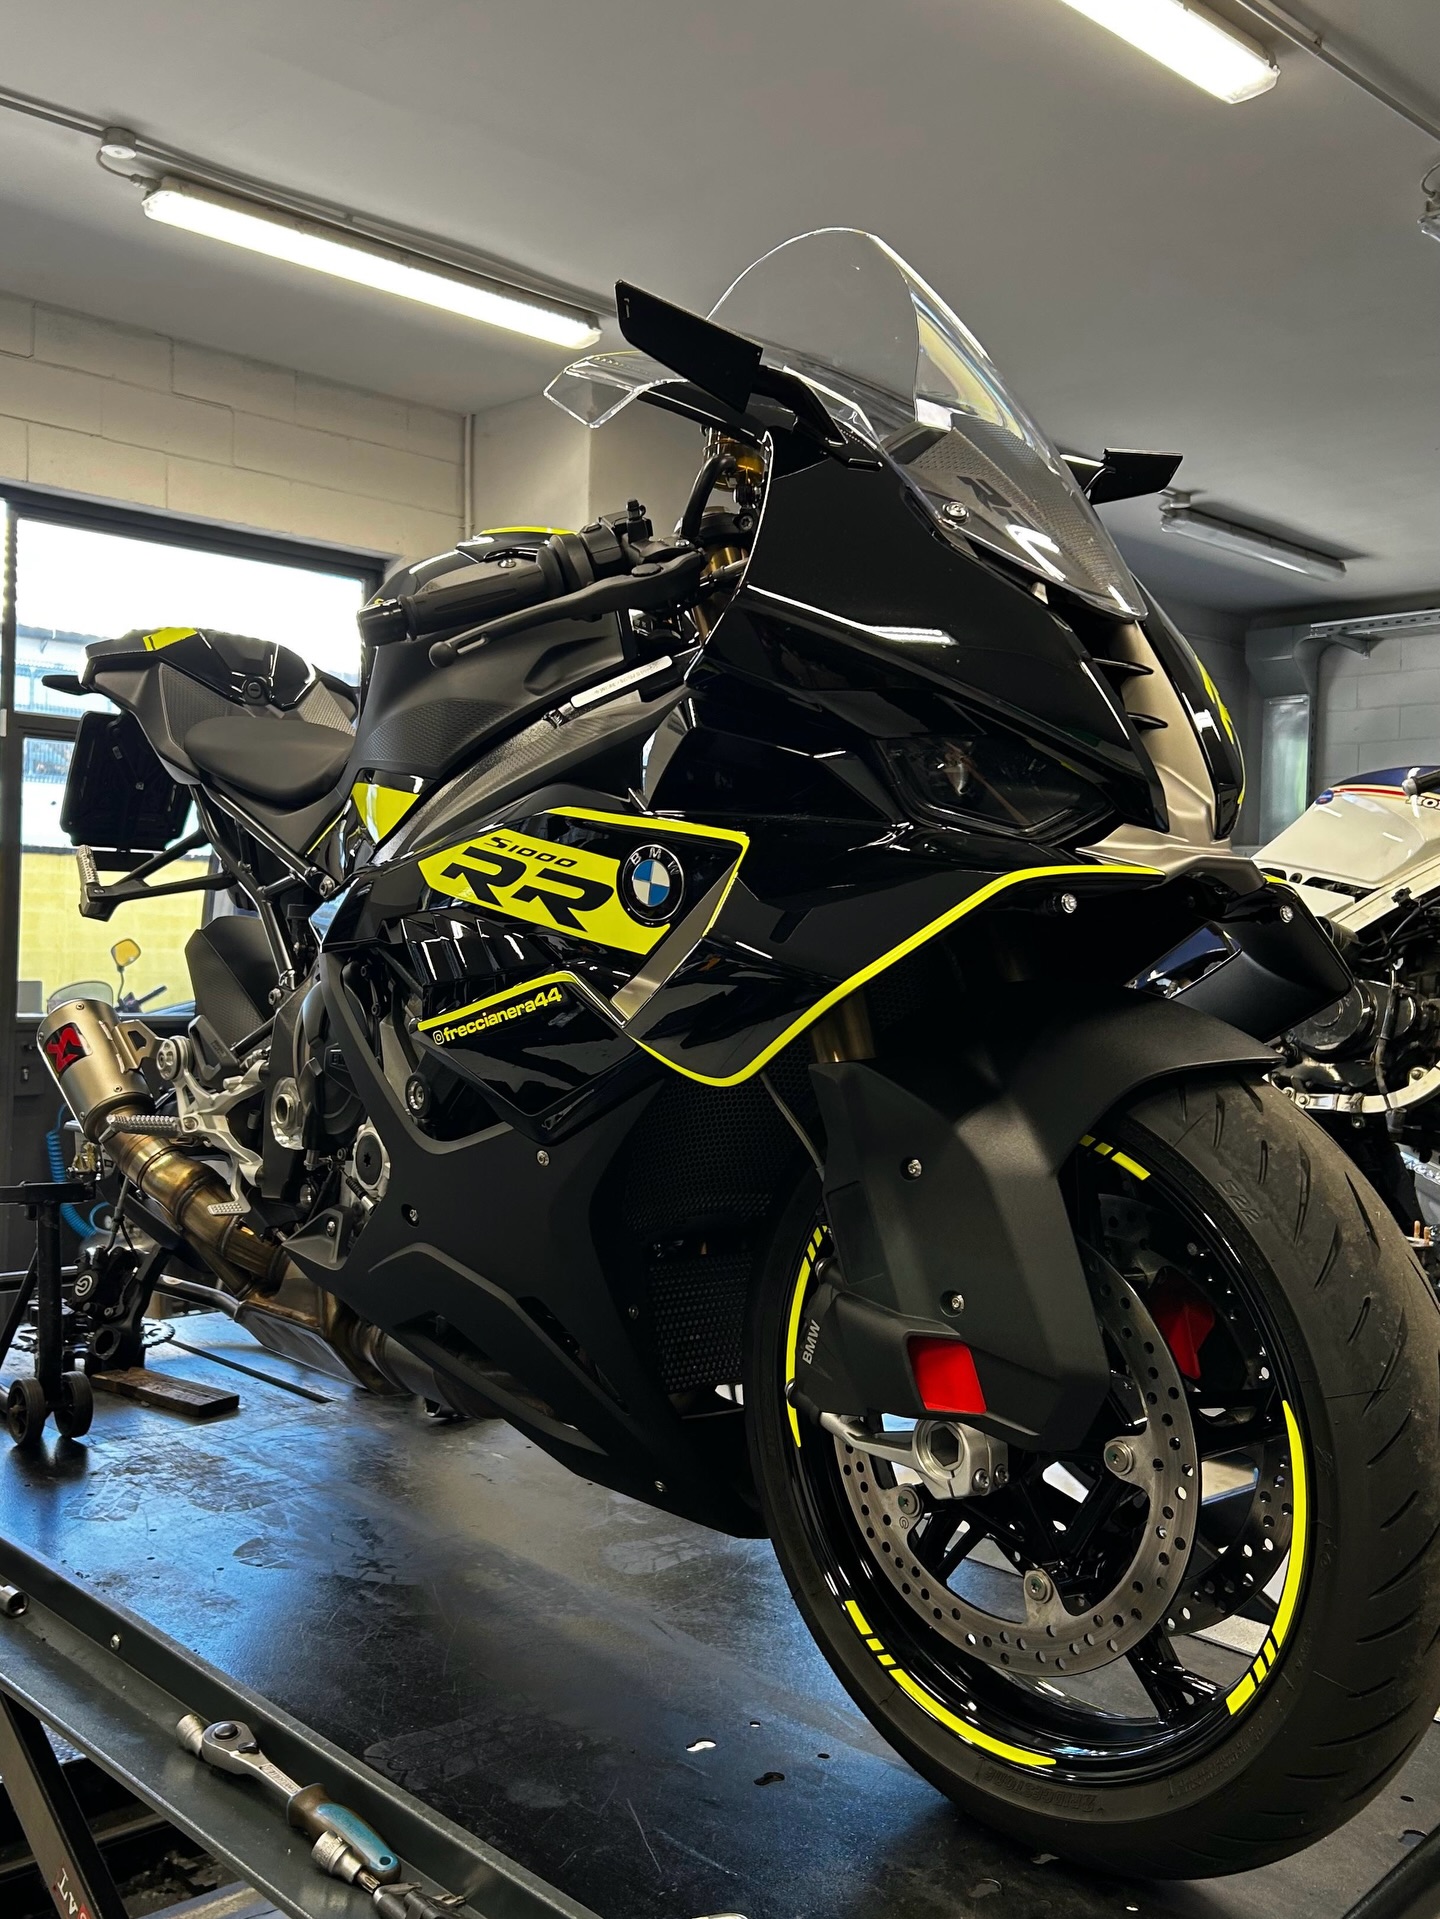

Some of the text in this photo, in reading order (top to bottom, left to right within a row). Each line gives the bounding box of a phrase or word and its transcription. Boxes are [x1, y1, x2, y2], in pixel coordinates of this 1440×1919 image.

[484, 836, 578, 868] S1000
[630, 847, 680, 876] BMW
[440, 845, 616, 934] RR
[802, 1319, 820, 1365] BMW
